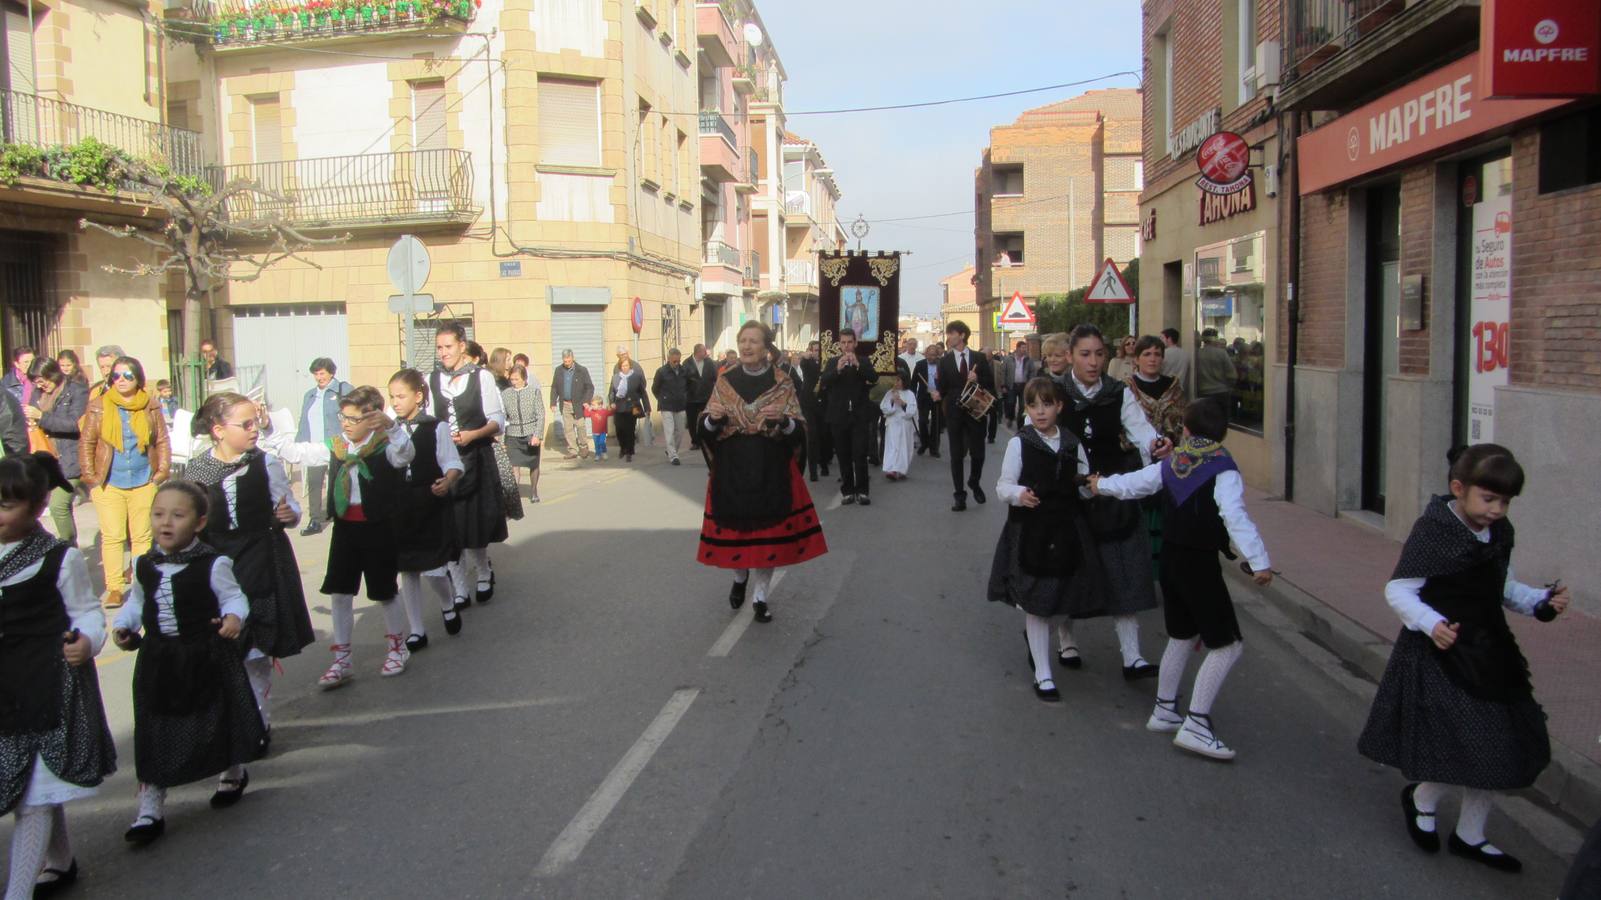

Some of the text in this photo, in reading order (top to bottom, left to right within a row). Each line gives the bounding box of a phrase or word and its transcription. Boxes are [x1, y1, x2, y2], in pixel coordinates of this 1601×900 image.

[1503, 47, 1589, 63] MAPFRE
[1369, 74, 1473, 155] MAPFRE
[1199, 177, 1249, 193] REST. TAHONA
[1481, 239, 1504, 256] Seguro
[1475, 256, 1504, 270] de Autos
[1472, 321, 1509, 374] 130
